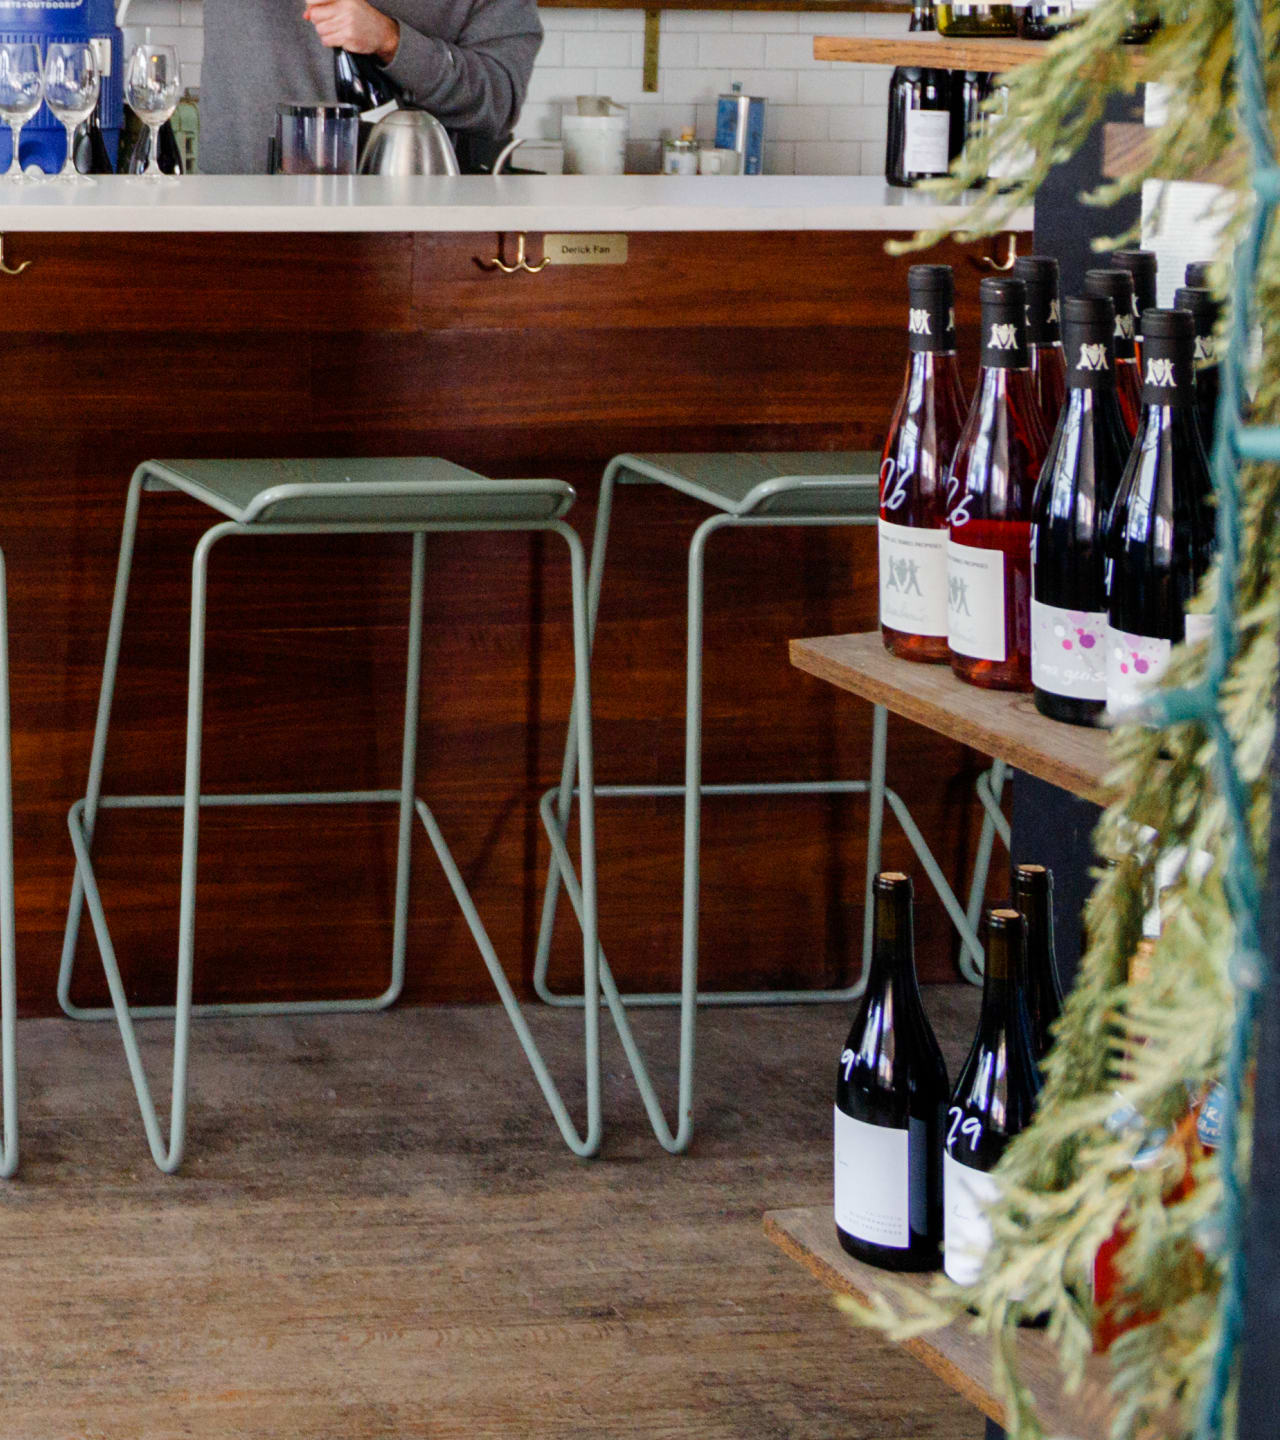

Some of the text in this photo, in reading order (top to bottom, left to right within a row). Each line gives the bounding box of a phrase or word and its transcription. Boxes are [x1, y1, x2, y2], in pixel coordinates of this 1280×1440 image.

[562, 244, 610, 254] Derick Fan
[947, 1106, 982, 1152] 29
